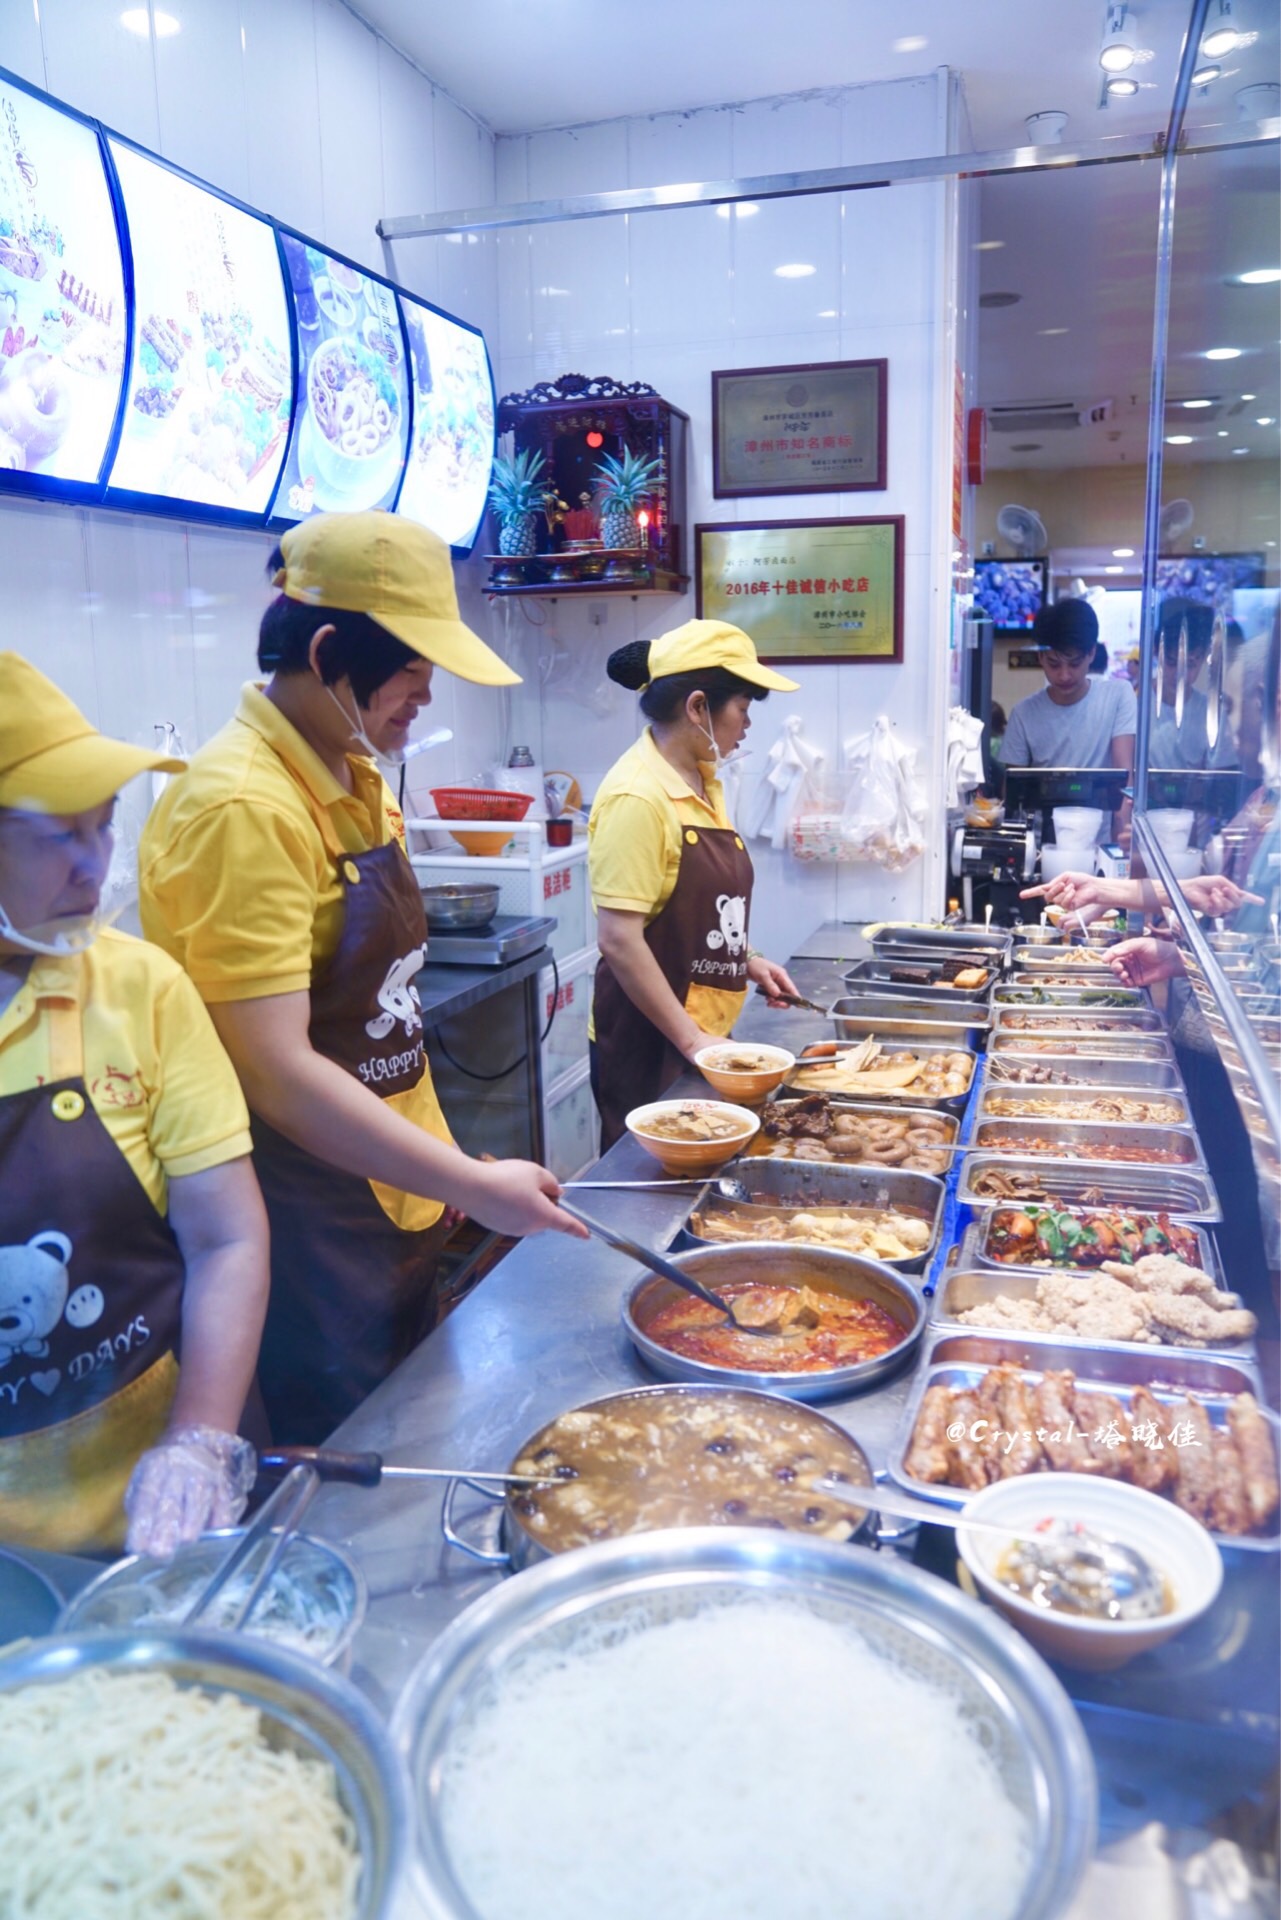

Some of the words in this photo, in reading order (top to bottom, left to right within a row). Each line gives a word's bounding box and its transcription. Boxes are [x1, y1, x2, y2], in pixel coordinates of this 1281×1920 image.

[744, 434, 853, 453] 漳州市知名商标
[726, 577, 869, 596] 2016年十佳诚信小吃店
[68, 1314, 150, 1382] DAYS
